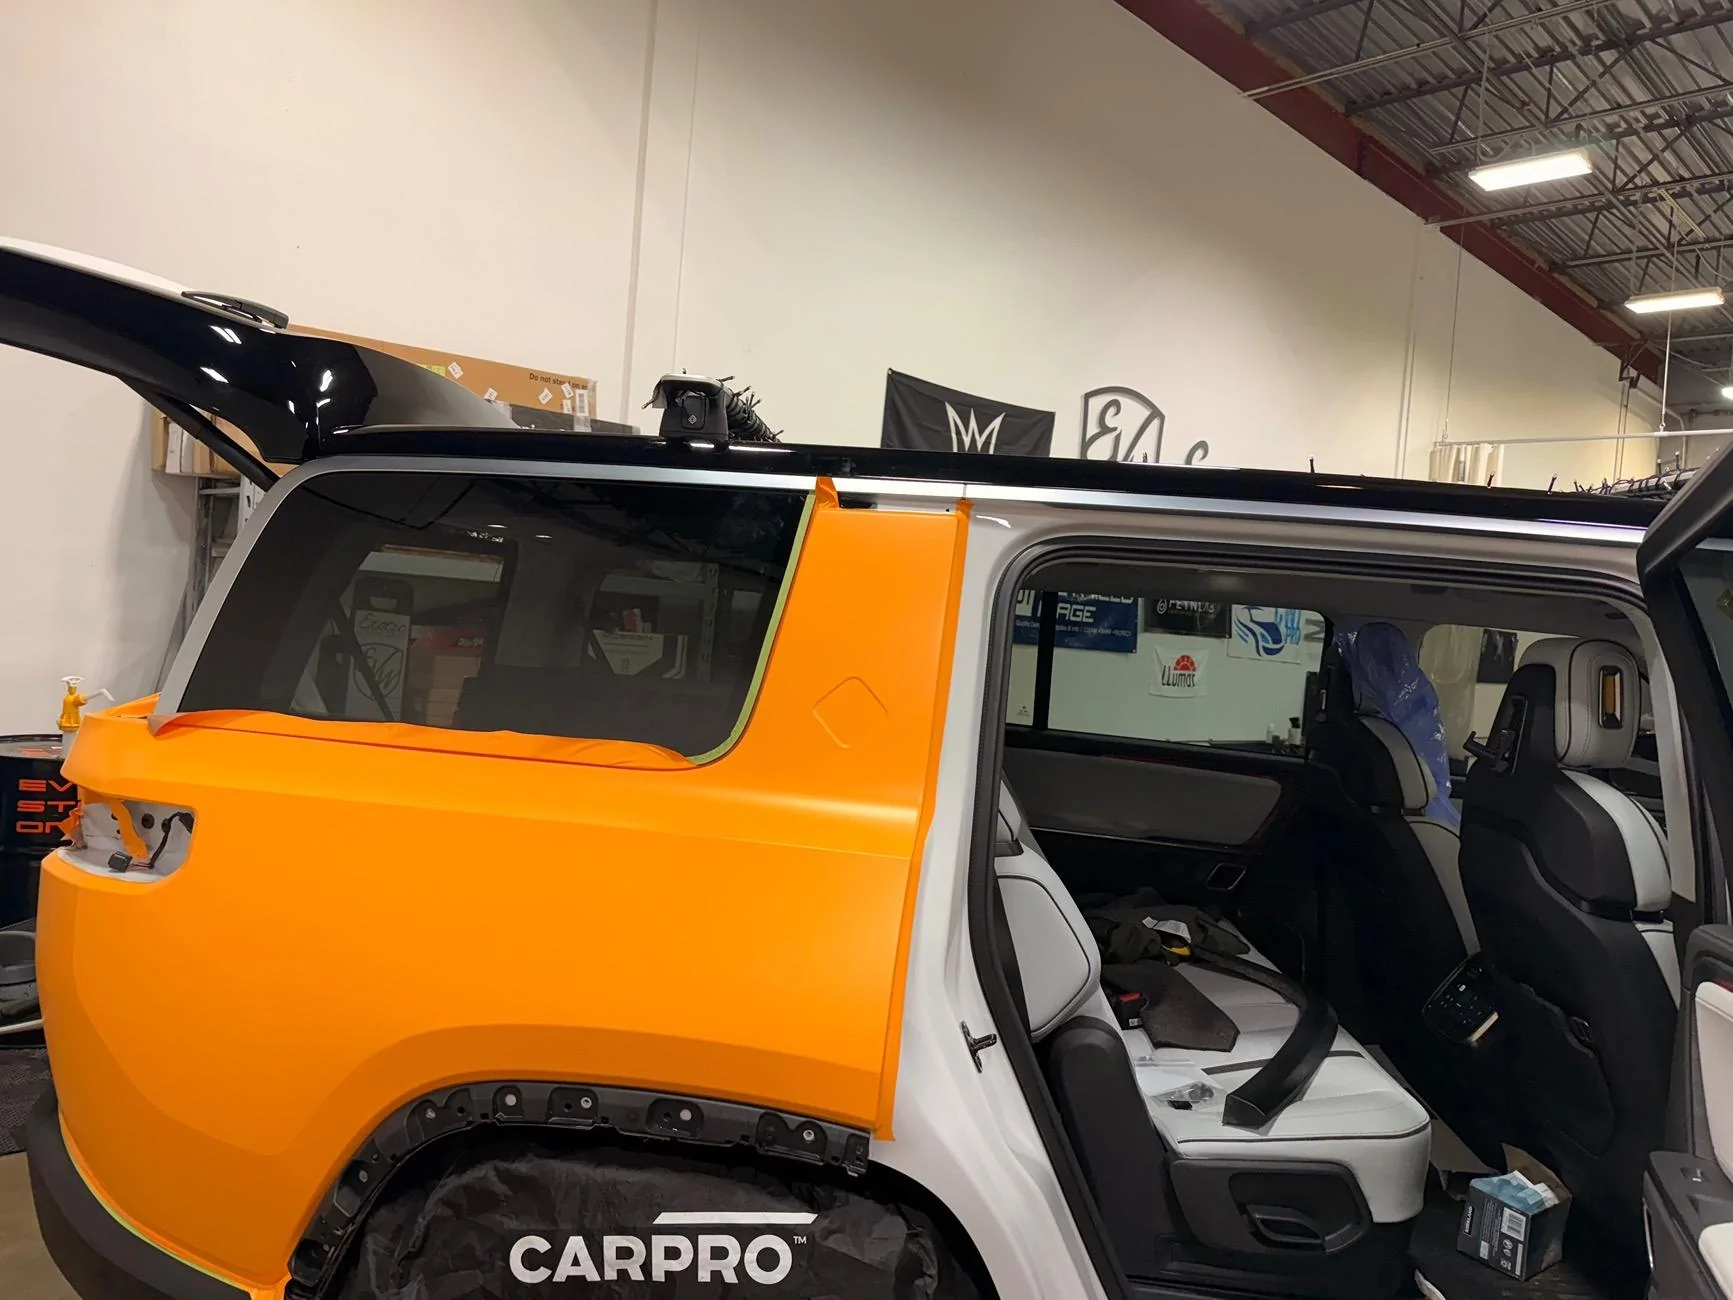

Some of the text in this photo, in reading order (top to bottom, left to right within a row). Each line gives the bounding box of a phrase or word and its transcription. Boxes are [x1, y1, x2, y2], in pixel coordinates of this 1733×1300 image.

[529, 372, 539, 381] Do
[540, 375, 551, 383] not
[509, 1234, 794, 1285] CARPRO
